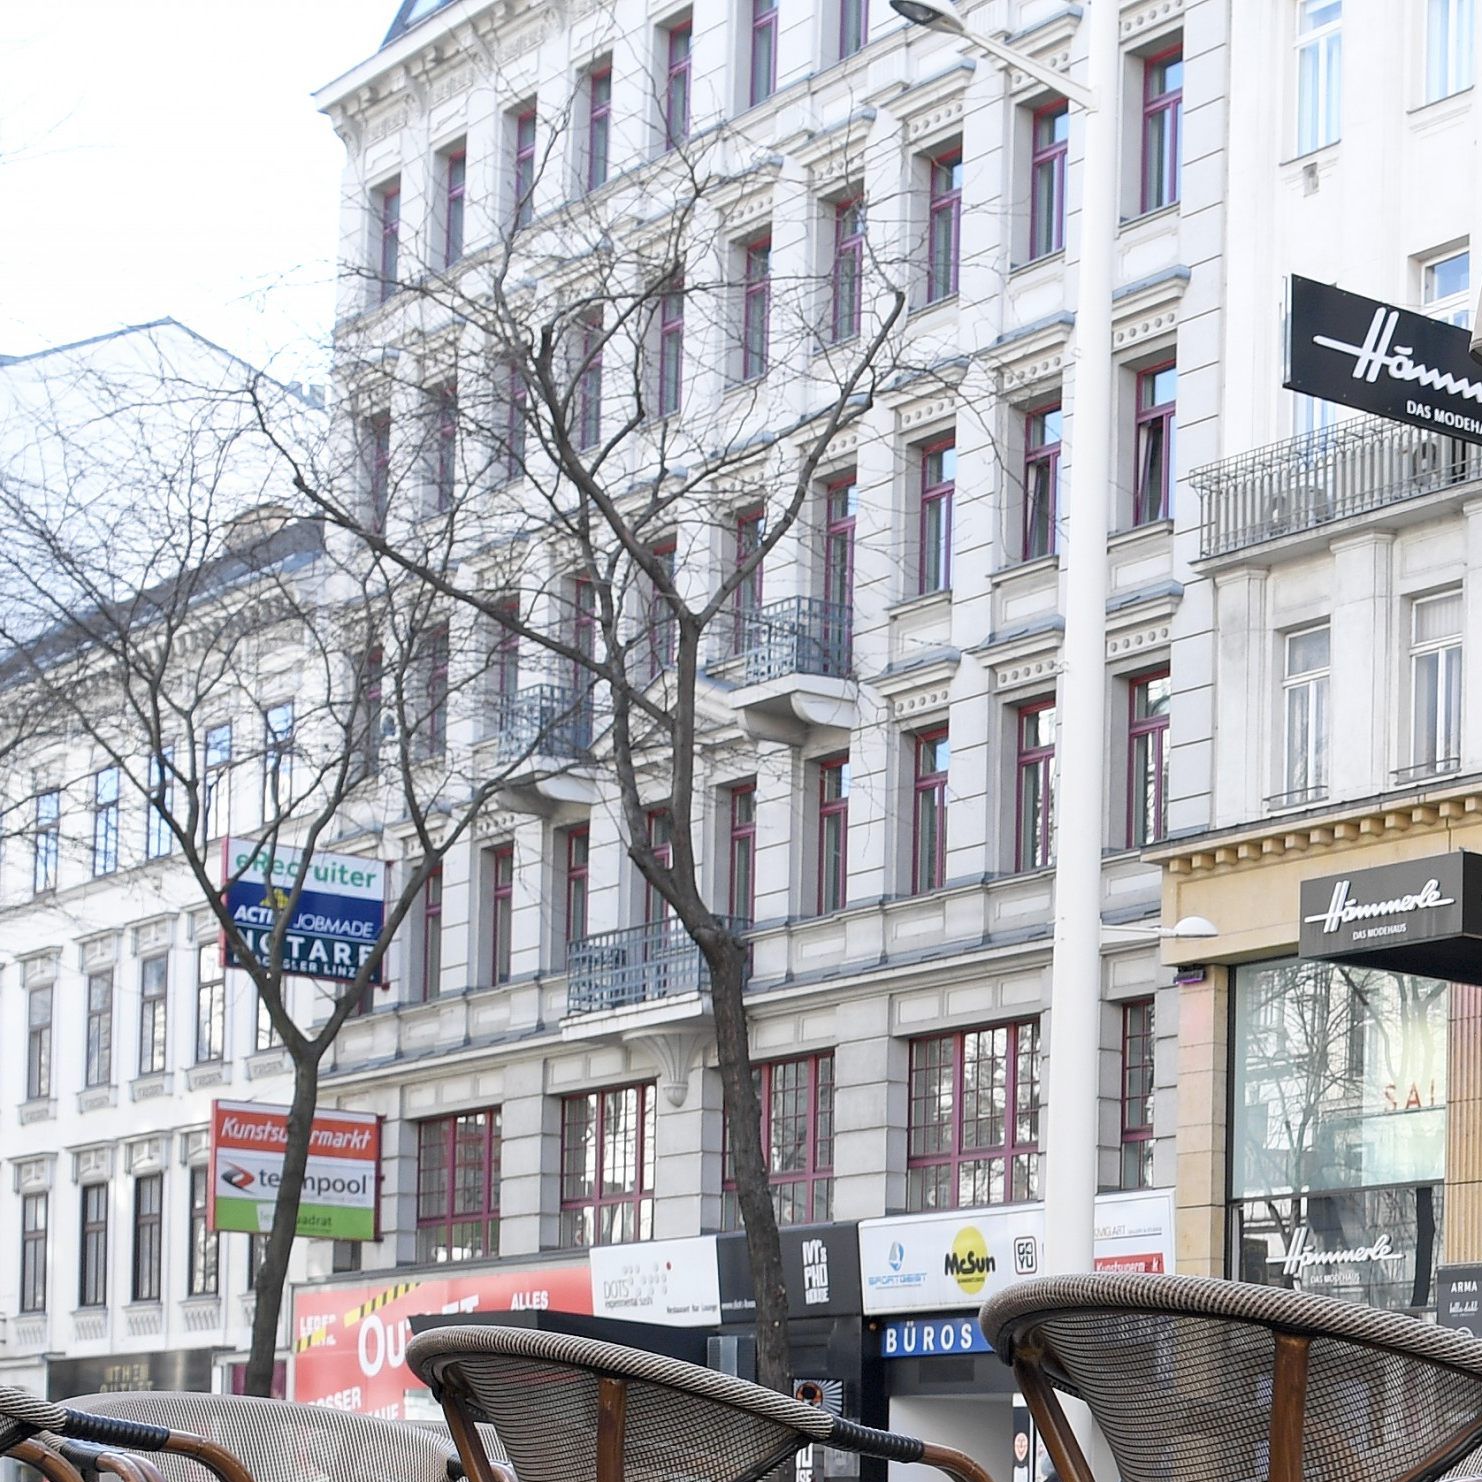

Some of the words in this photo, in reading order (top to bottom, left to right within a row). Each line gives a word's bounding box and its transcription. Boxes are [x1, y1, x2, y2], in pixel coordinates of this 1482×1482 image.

[1406, 400, 1432, 420] DAS
[235, 852, 377, 888] eRecuiter
[1304, 879, 1455, 933] Hämmerle
[293, 913, 375, 938] JOBMADE
[1353, 929, 1367, 940] DAS
[1368, 923, 1406, 938] MODEHAUS
[221, 1117, 371, 1150] Kunstsurmarkt
[259, 1168, 367, 1196] tempool
[944, 1251, 996, 1276] McSun
[1265, 1227, 1406, 1275] Hämmerle
[1311, 1275, 1323, 1285] DAS
[1451, 1281, 1478, 1293] ARMA
[511, 1290, 549, 1311] ALLES
[886, 1321, 973, 1352] BÜROS
